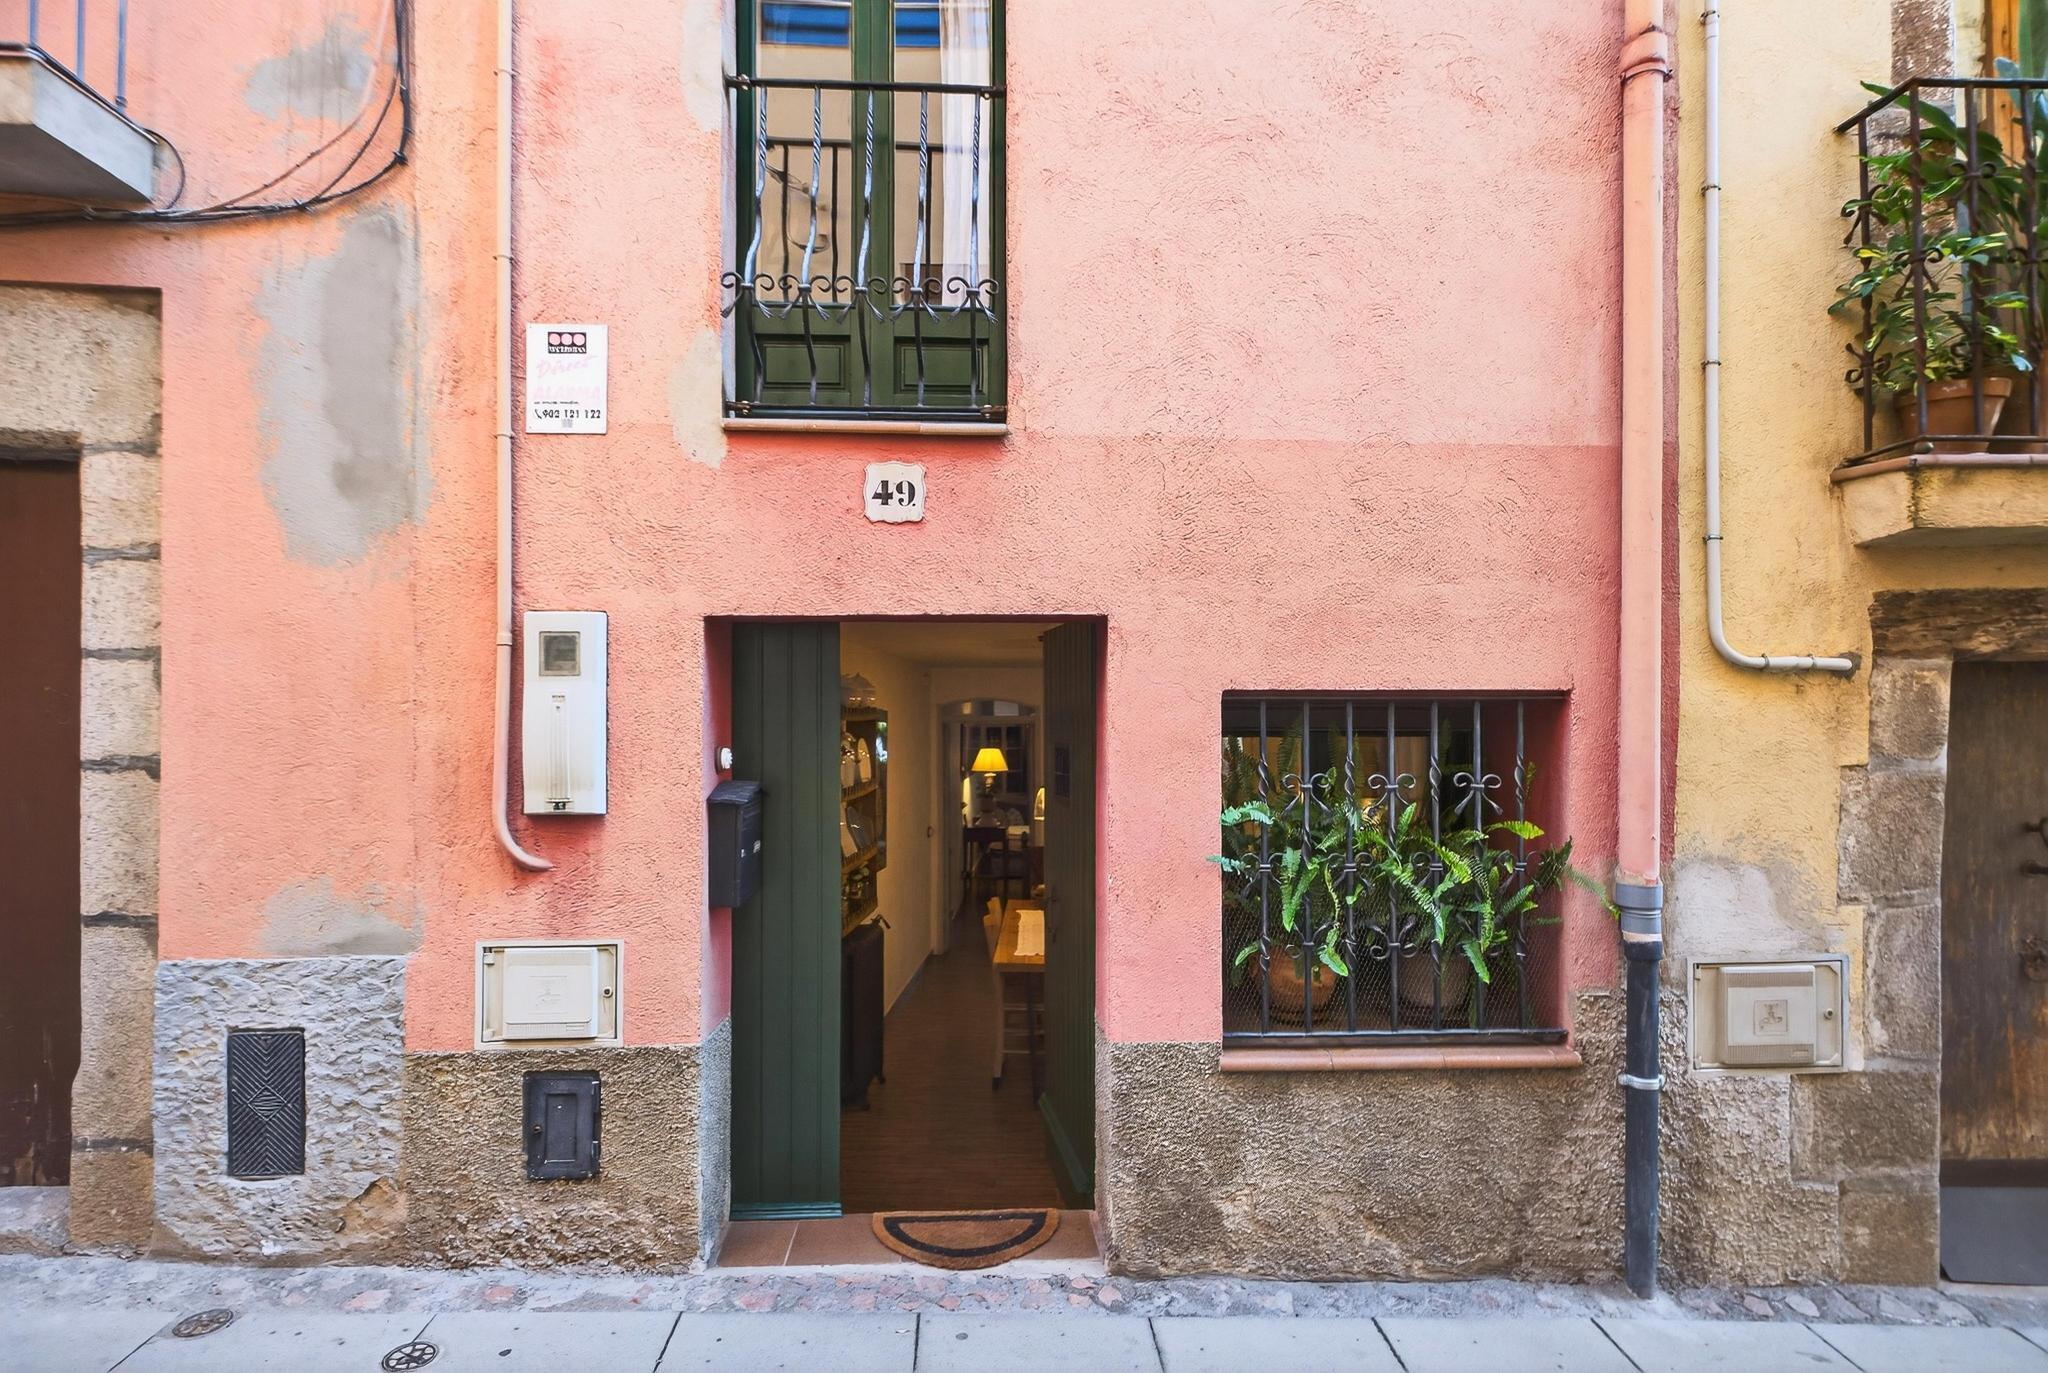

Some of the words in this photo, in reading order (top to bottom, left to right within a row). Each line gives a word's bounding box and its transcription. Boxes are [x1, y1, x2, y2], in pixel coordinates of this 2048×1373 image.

[542, 409, 560, 419] 902
[564, 409, 579, 419] 121
[585, 409, 601, 419] 122
